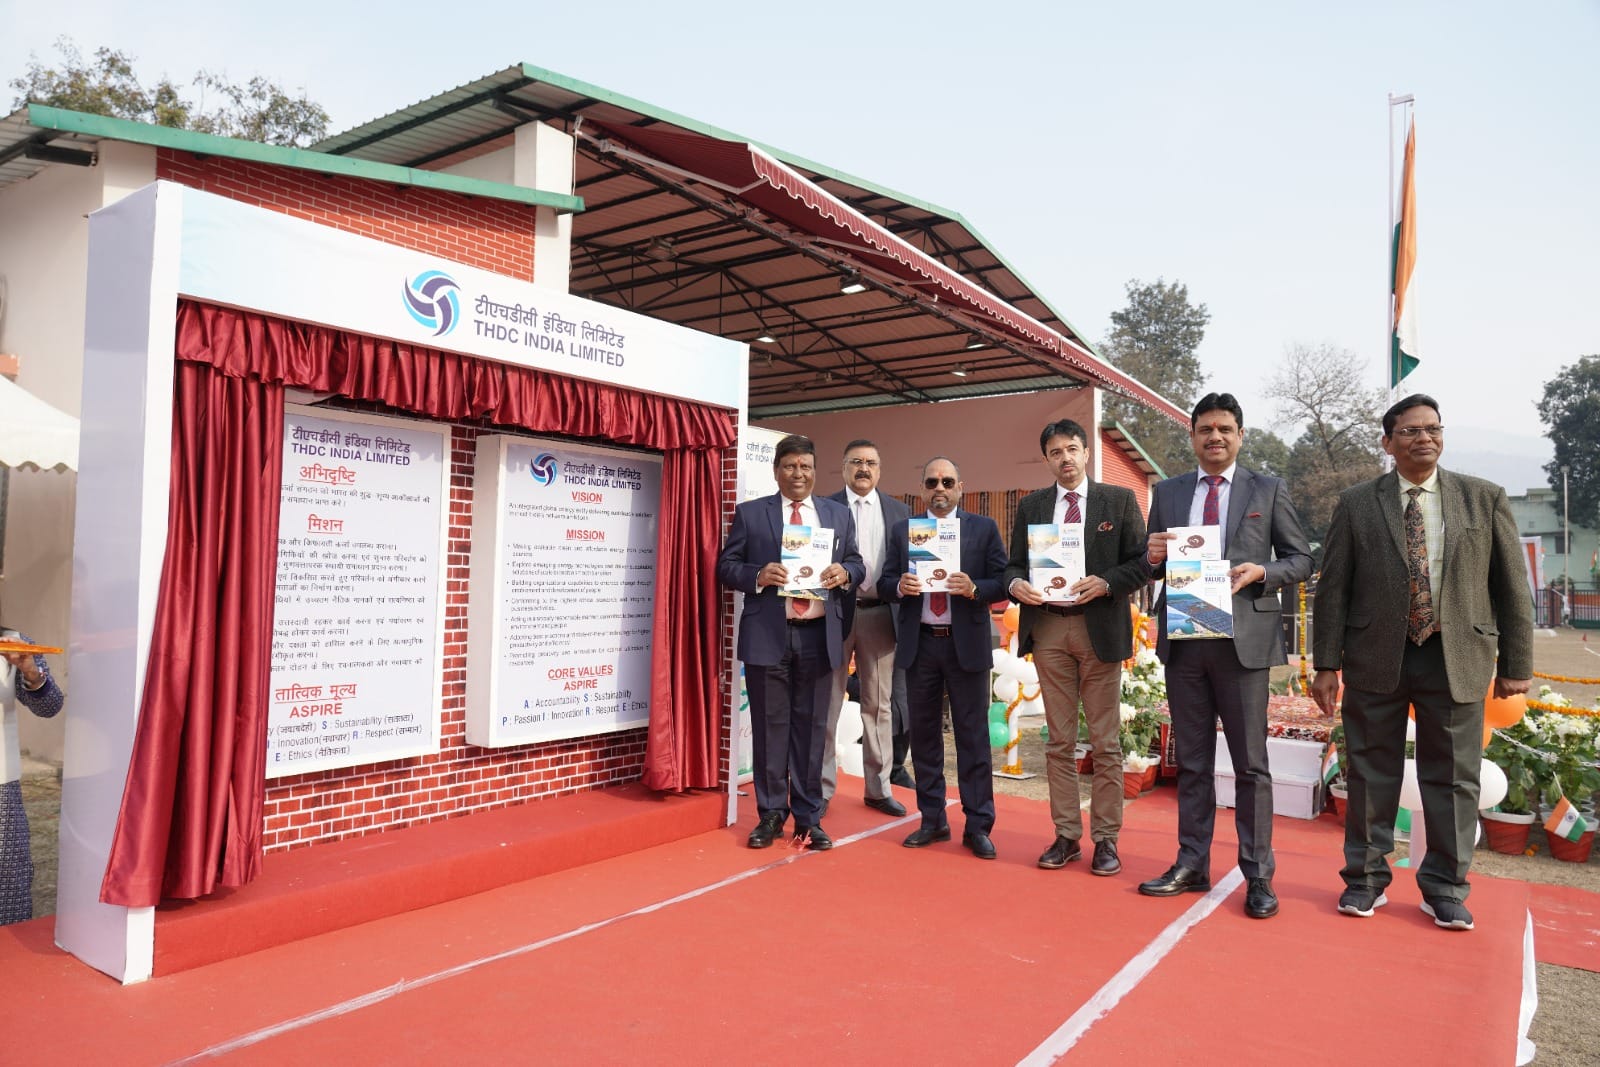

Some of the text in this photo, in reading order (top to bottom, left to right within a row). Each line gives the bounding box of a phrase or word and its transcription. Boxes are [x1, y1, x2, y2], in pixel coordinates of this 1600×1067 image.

[474, 294, 625, 349] टीएचडीसी इंडिया लिमिटेड
[473, 320, 625, 368] THDC INDIA LIMITED
[291, 426, 411, 454] टीएचडीसी इंडिया लिमिटेड
[291, 442, 411, 467] THDC INDIA LIMITED
[563, 475, 642, 491] THDC INDIA LIMITED
[571, 491, 603, 503] VISION
[307, 513, 344, 532] मिशन
[566, 528, 605, 541] MISSION
[547, 664, 614, 680] CORE VALUES
[329, 682, 358, 702] मूल्य
[563, 678, 598, 691] ASPIRE
[524, 689, 632, 709] A Accountability S Sustainability
[289, 702, 343, 719] ASPIRE
[502, 716, 508, 727] P
[514, 713, 541, 725] Passion
[551, 708, 584, 721] Innovation
[585, 706, 590, 716] R
[595, 703, 620, 715] Respect
[622, 703, 627, 711] E
[321, 720, 328, 730] S
[335, 716, 383, 730] Sustainability
[352, 731, 359, 740] R
[365, 727, 395, 739] Respect
[275, 752, 281, 762] E
[288, 749, 313, 761] Ethics
